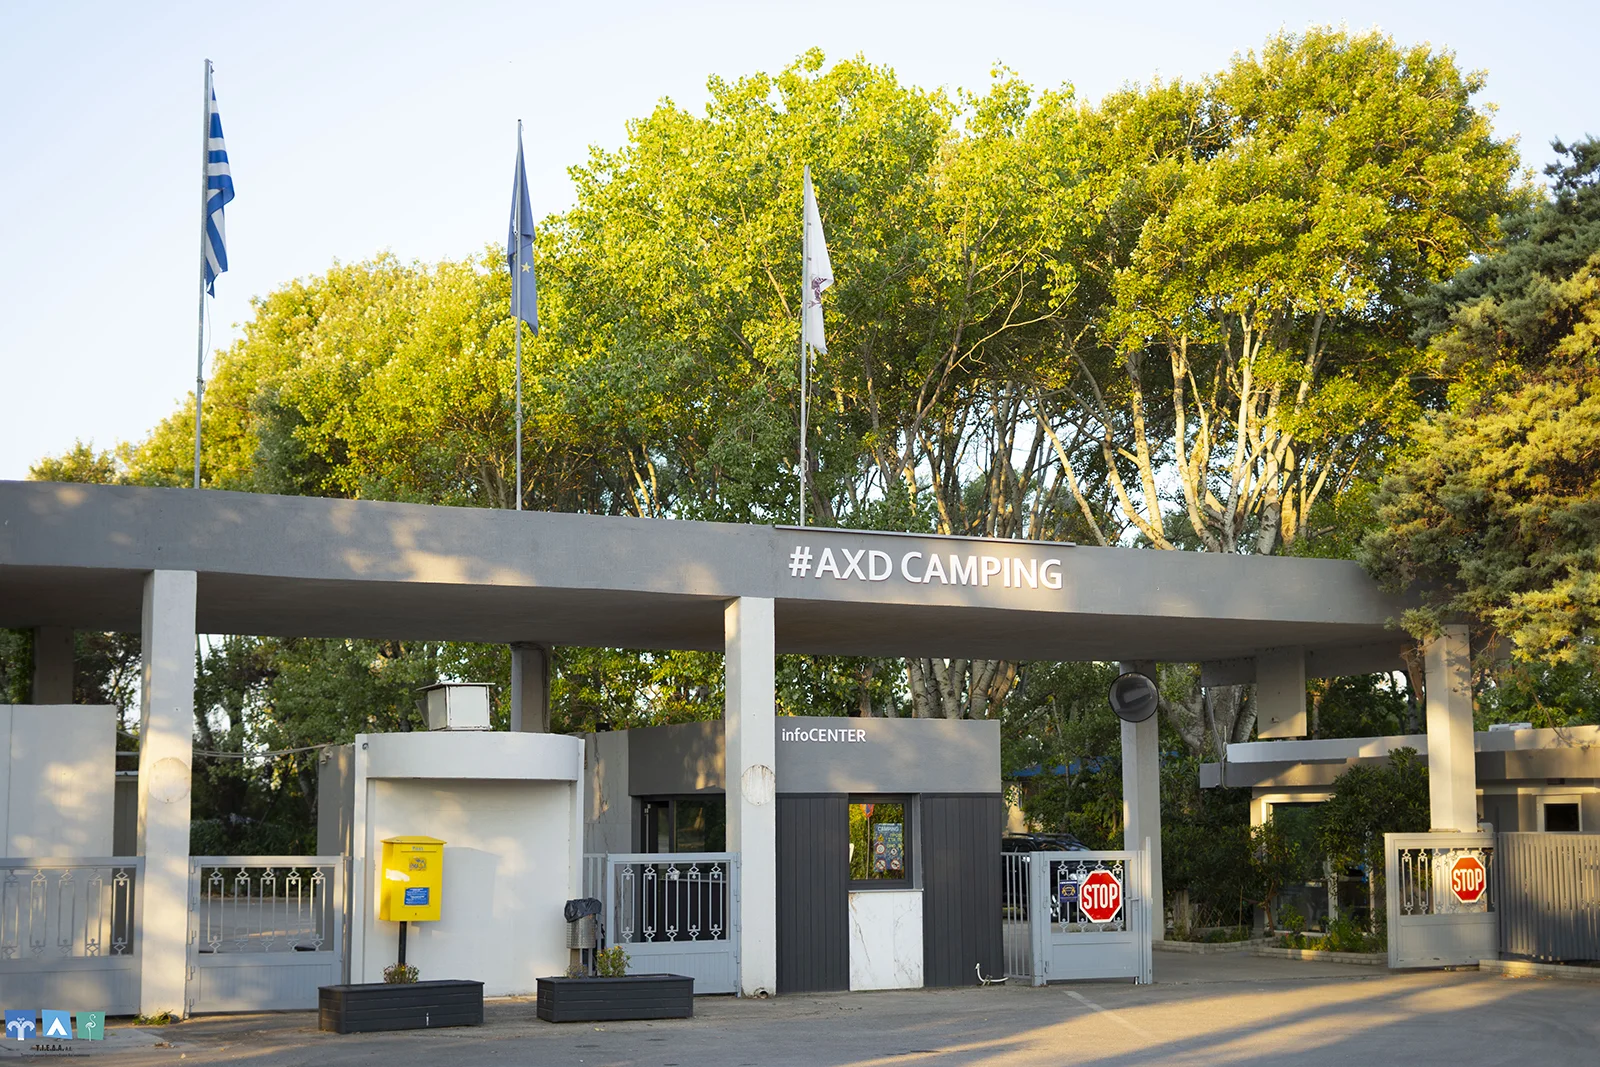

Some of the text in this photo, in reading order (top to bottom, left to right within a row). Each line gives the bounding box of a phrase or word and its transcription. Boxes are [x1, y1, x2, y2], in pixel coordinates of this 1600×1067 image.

[788, 545, 1063, 590] #AXD CAMPING
[782, 727, 866, 742] infoCENTER
[1453, 868, 1483, 892] STOP
[1083, 883, 1118, 910] STOP
